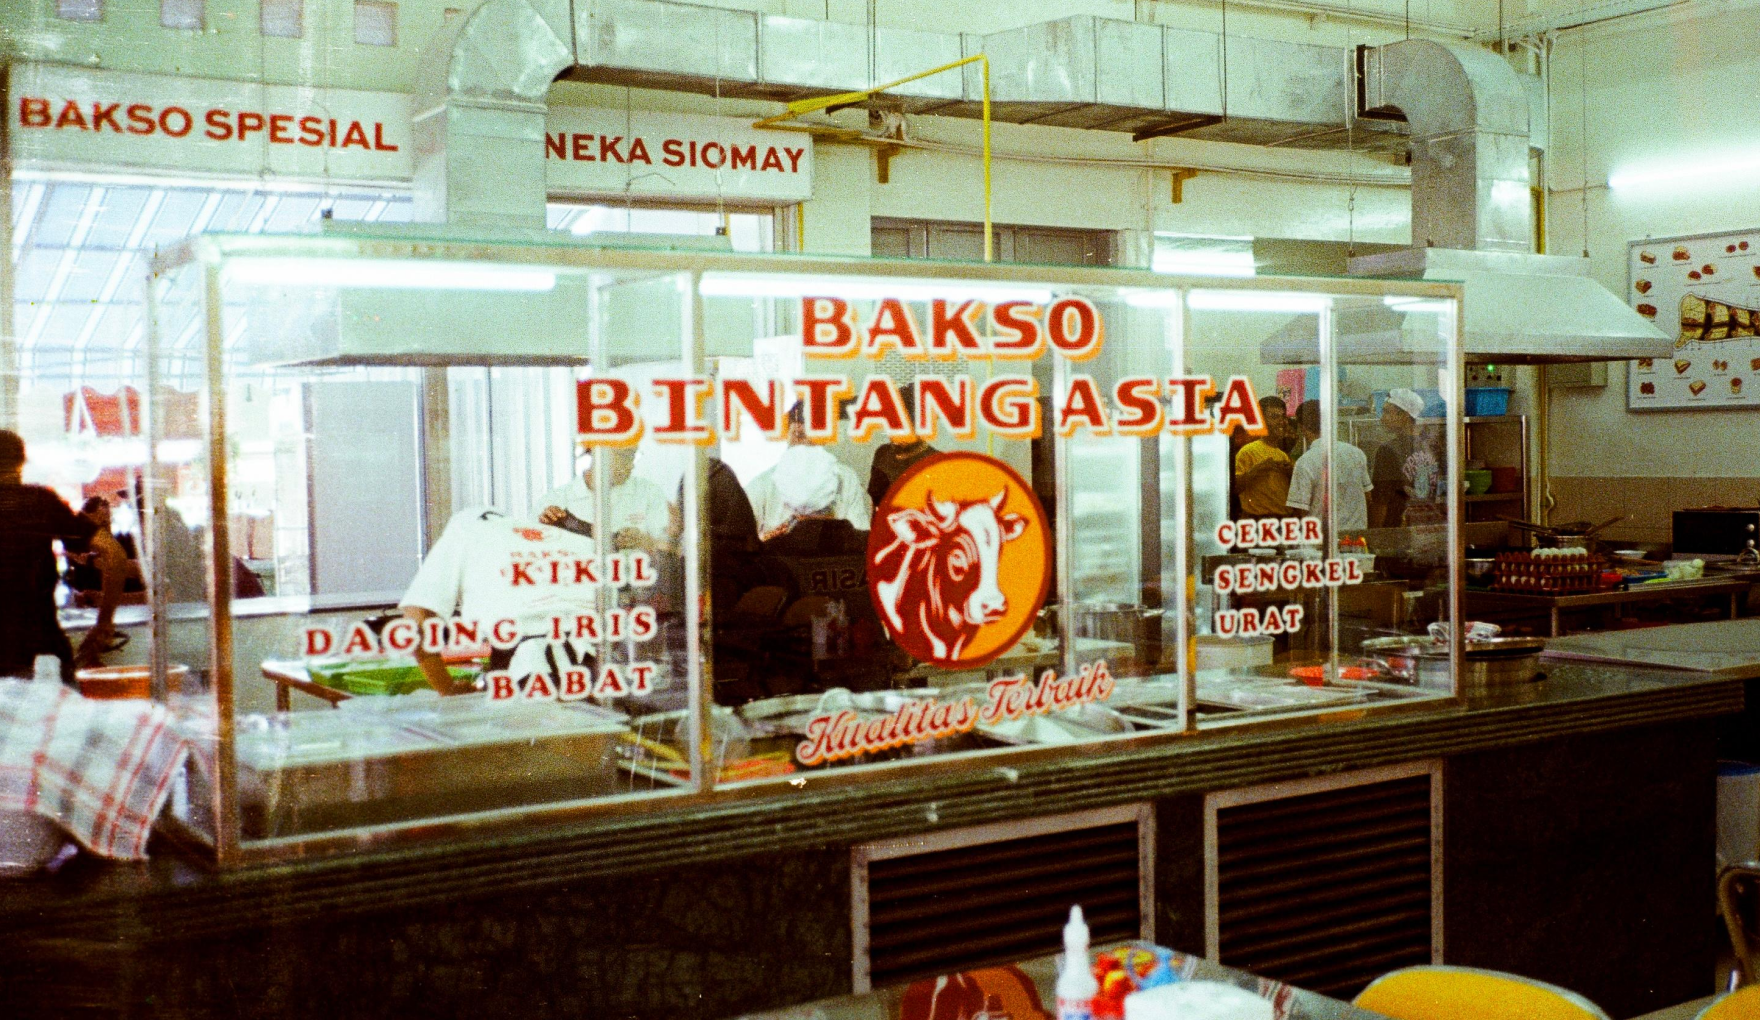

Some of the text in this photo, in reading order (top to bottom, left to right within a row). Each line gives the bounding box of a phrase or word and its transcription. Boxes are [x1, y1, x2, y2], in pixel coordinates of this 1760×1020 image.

[19, 96, 399, 152] BAKSO SPESIAL
[661, 138, 804, 173] SIOMAY
[801, 295, 1103, 362] BAKSO
[575, 374, 1268, 448] BINTANG ASIA
[1217, 520, 1321, 546] CEKER
[511, 557, 652, 586] KIKIL
[1217, 560, 1362, 591] SENGKEL
[304, 608, 656, 656] DAGING IRIS
[1219, 608, 1300, 634] URAT
[493, 664, 655, 701] BABAT
[796, 660, 1117, 766] Kualitas Terbaik
